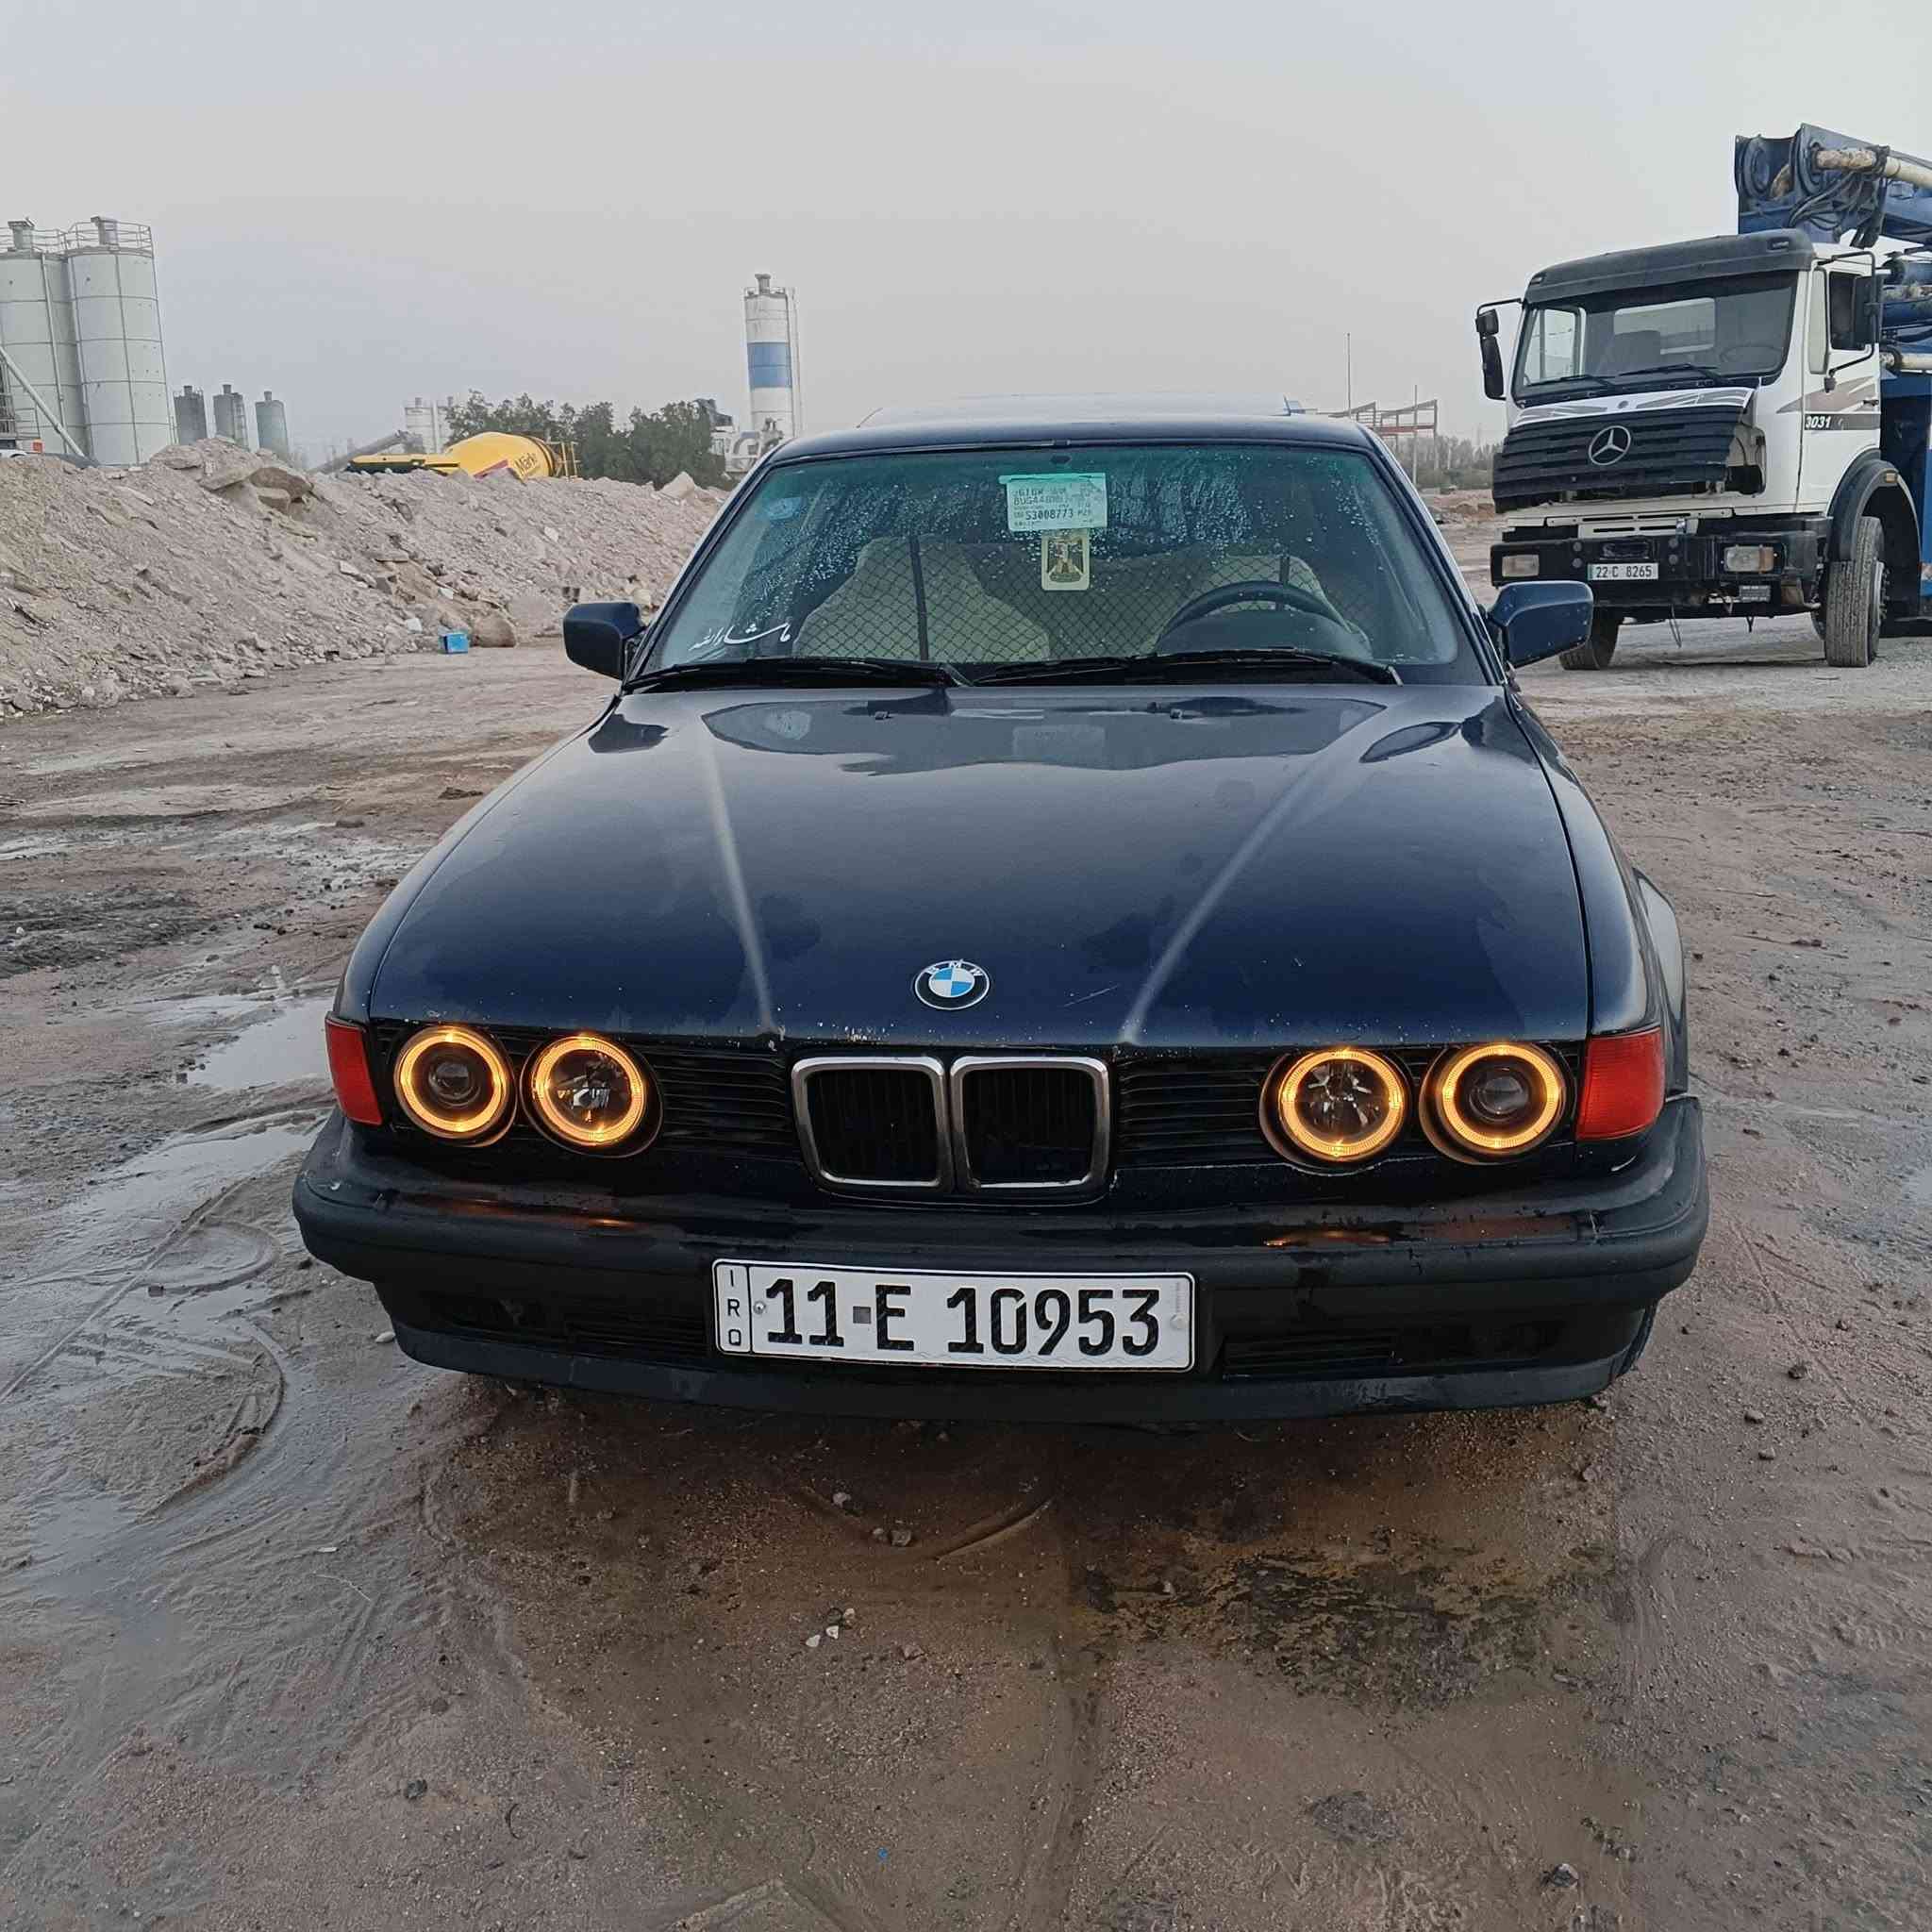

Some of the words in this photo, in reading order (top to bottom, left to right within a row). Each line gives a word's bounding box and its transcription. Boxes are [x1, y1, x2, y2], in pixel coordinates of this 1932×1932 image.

[1805, 415, 1831, 429] 3031
[1595, 566, 1607, 578] 22
[1611, 566, 1619, 577] C
[1625, 565, 1652, 577] 8265
[924, 959, 983, 976] BMW
[726, 1269, 742, 1347] IRQ
[766, 1278, 844, 1347] 11
[875, 1284, 915, 1351] E
[946, 1287, 1160, 1357] 10953
